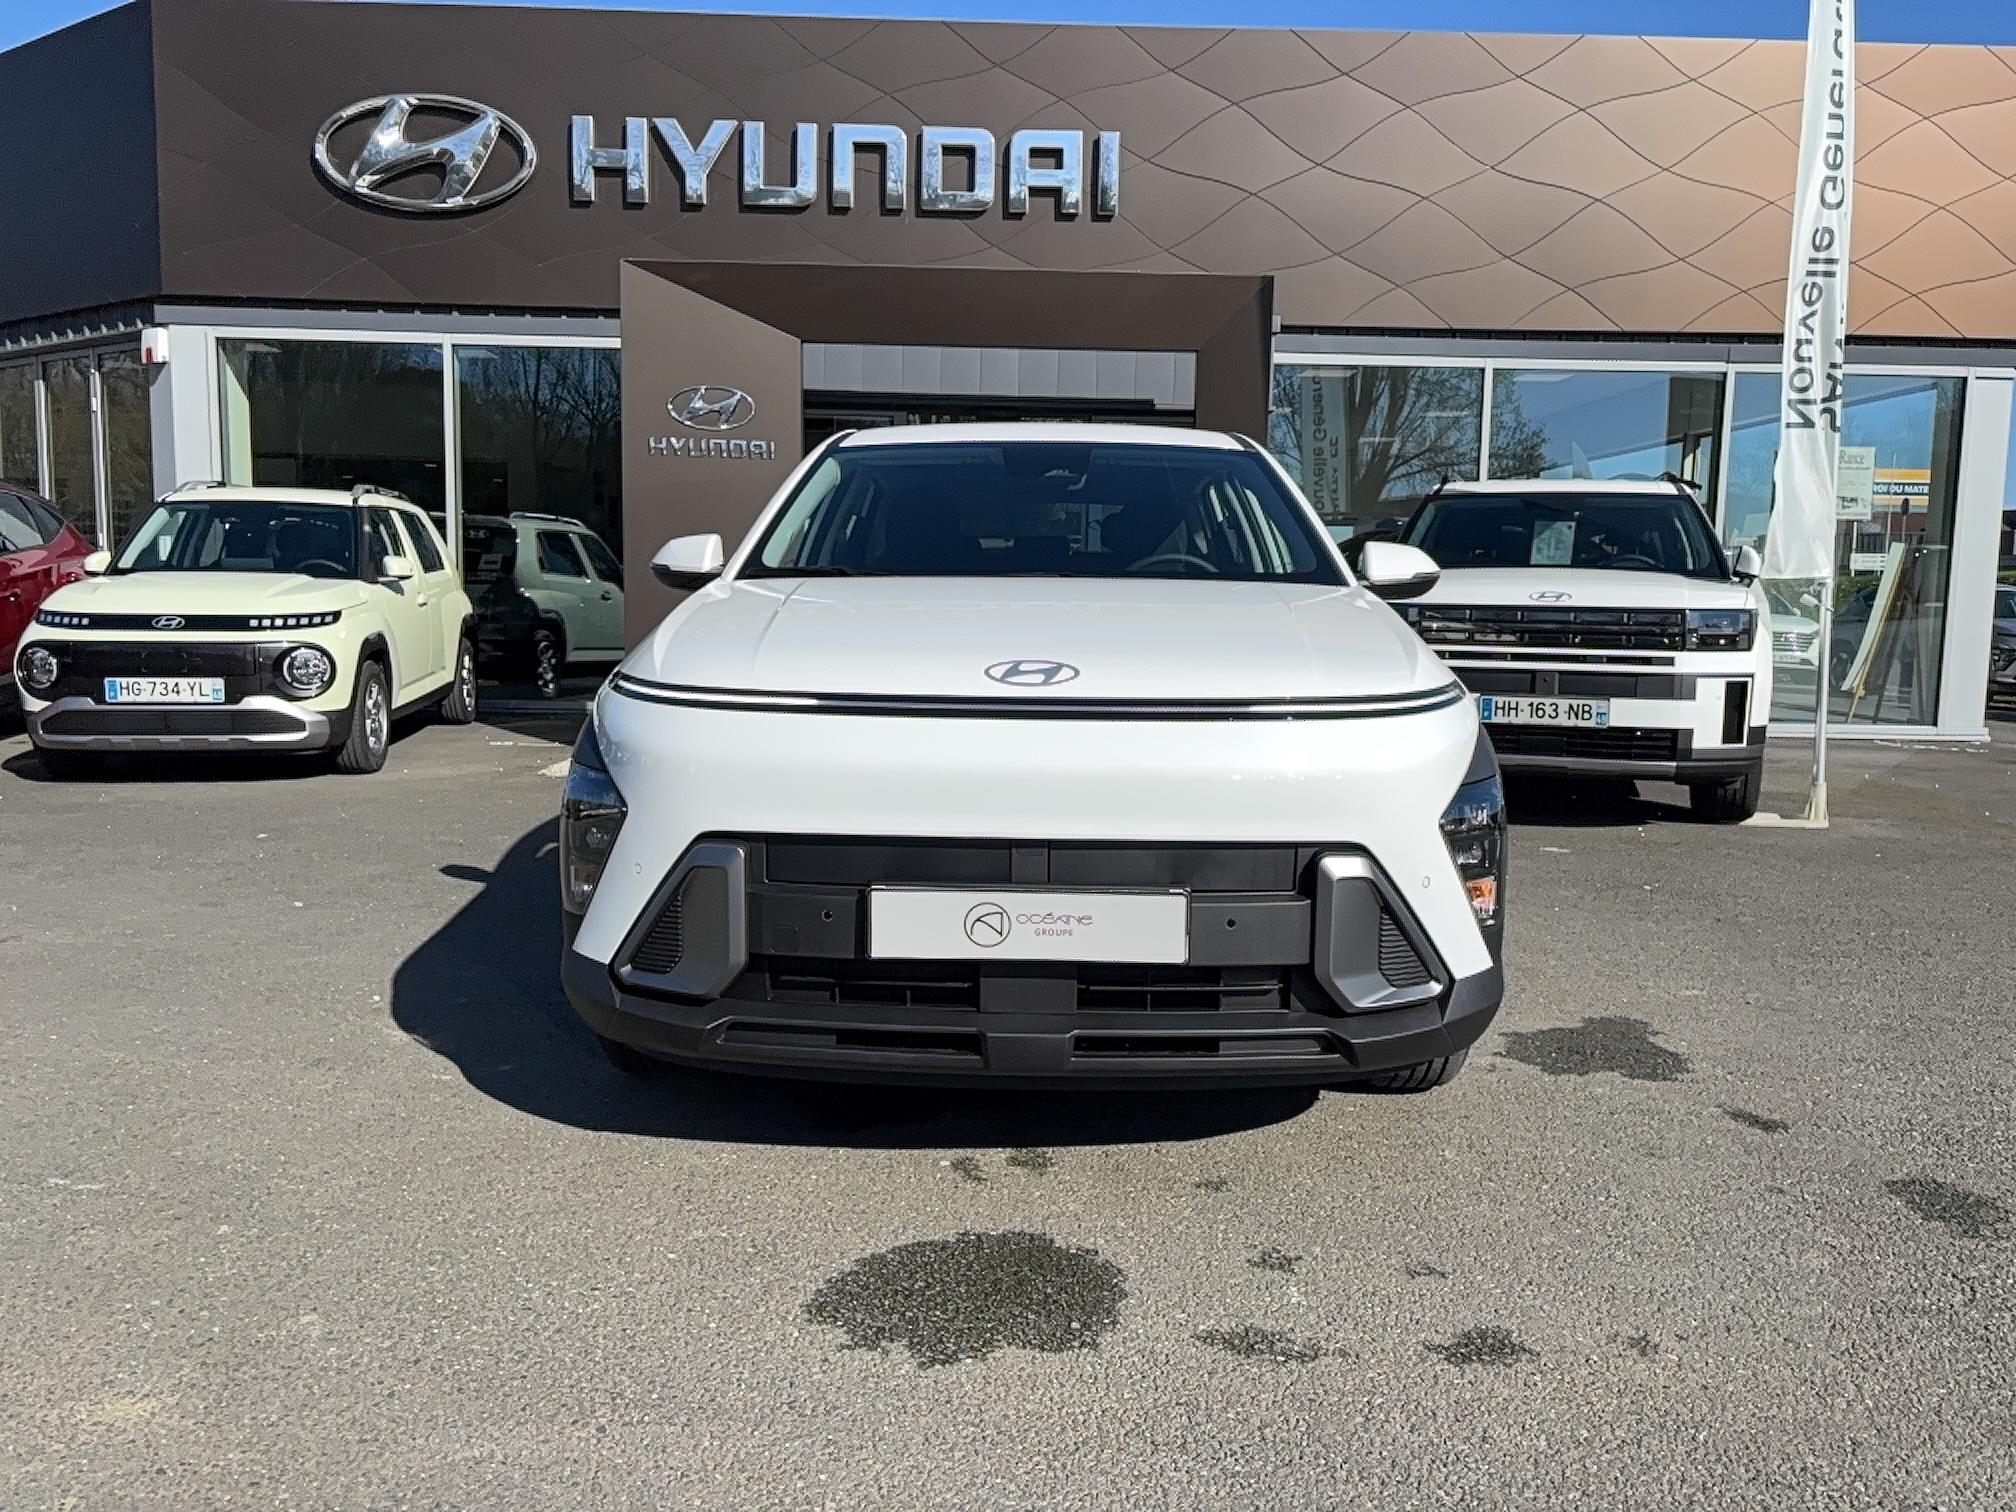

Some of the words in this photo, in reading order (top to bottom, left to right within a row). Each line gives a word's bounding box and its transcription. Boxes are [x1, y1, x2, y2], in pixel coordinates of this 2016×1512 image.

[569, 114, 1121, 218] HYUNDAI
[648, 435, 775, 460] HYUNDAI
[1889, 485, 1903, 494] DU
[1034, 927, 1073, 937] GROUPE
